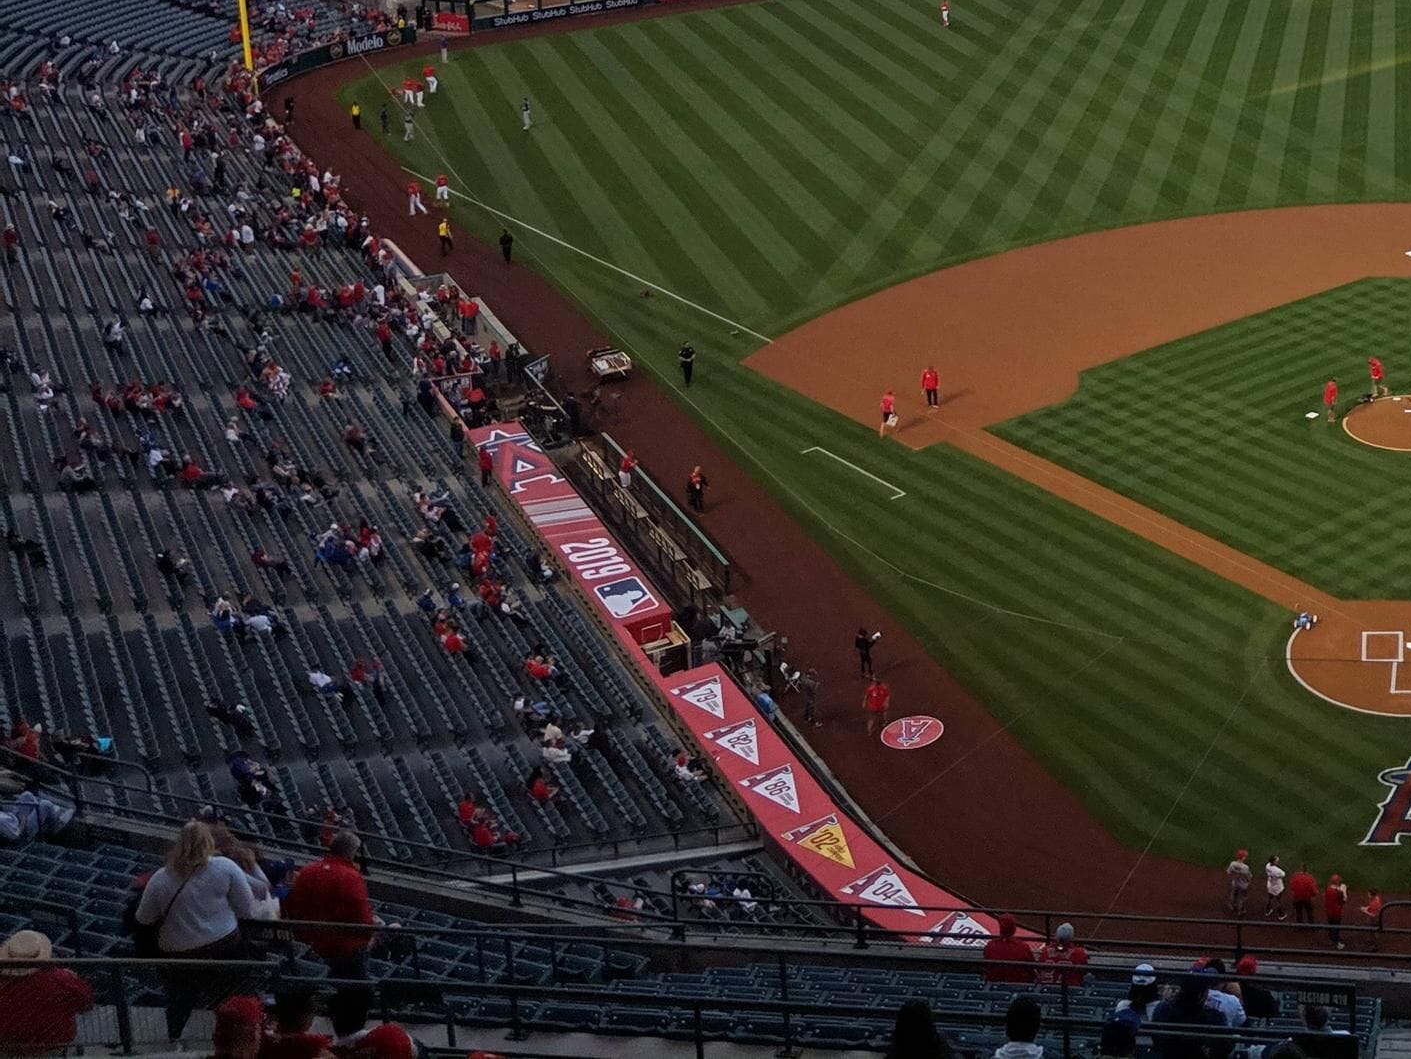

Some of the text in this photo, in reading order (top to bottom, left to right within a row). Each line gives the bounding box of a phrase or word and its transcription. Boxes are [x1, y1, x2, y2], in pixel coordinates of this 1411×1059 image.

[494, 14, 529, 26] StubHub
[532, 9, 566, 20] StubHub
[569, 4, 602, 14] StubHub
[347, 35, 384, 55] Modelo
[560, 537, 631, 580] 2019
[872, 880, 902, 901] '04
